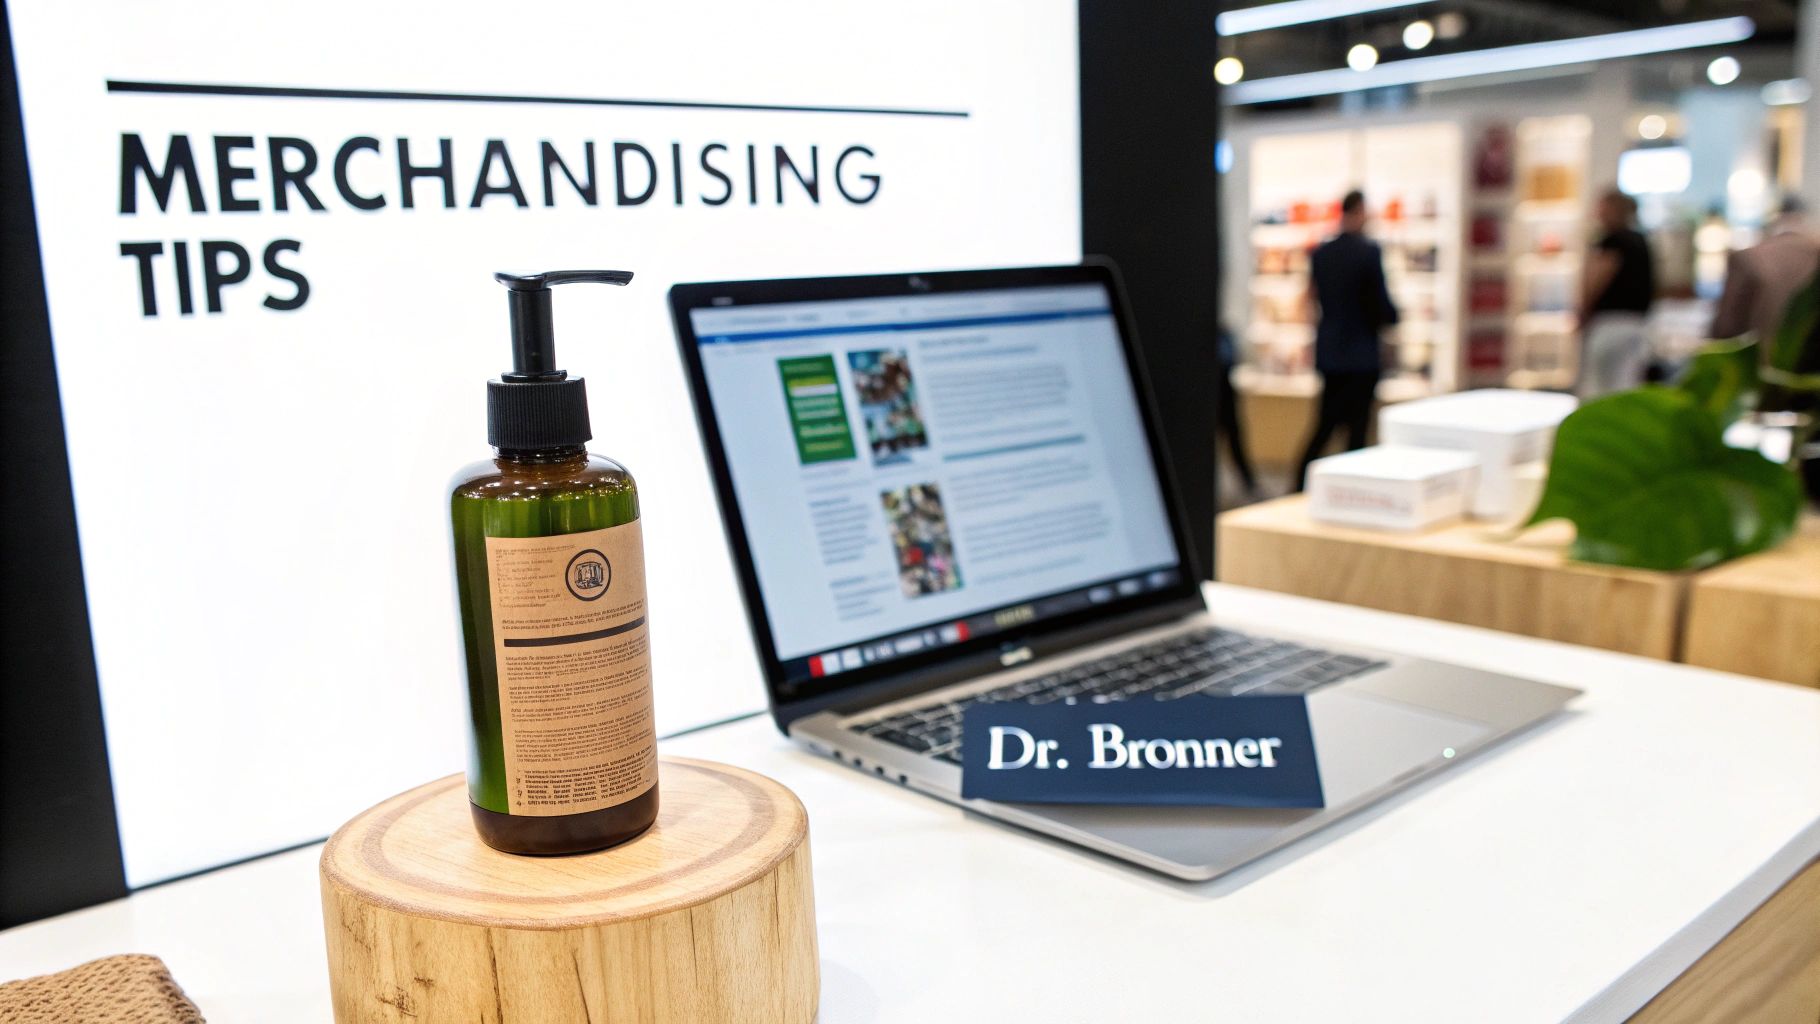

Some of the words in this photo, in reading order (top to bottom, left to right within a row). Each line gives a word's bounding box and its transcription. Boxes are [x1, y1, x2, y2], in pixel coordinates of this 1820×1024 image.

[119, 133, 882, 215] MERCHANDISING
[119, 238, 311, 317] TIPS
[987, 725, 1069, 770] Dr.
[1087, 723, 1282, 769] Bronner
